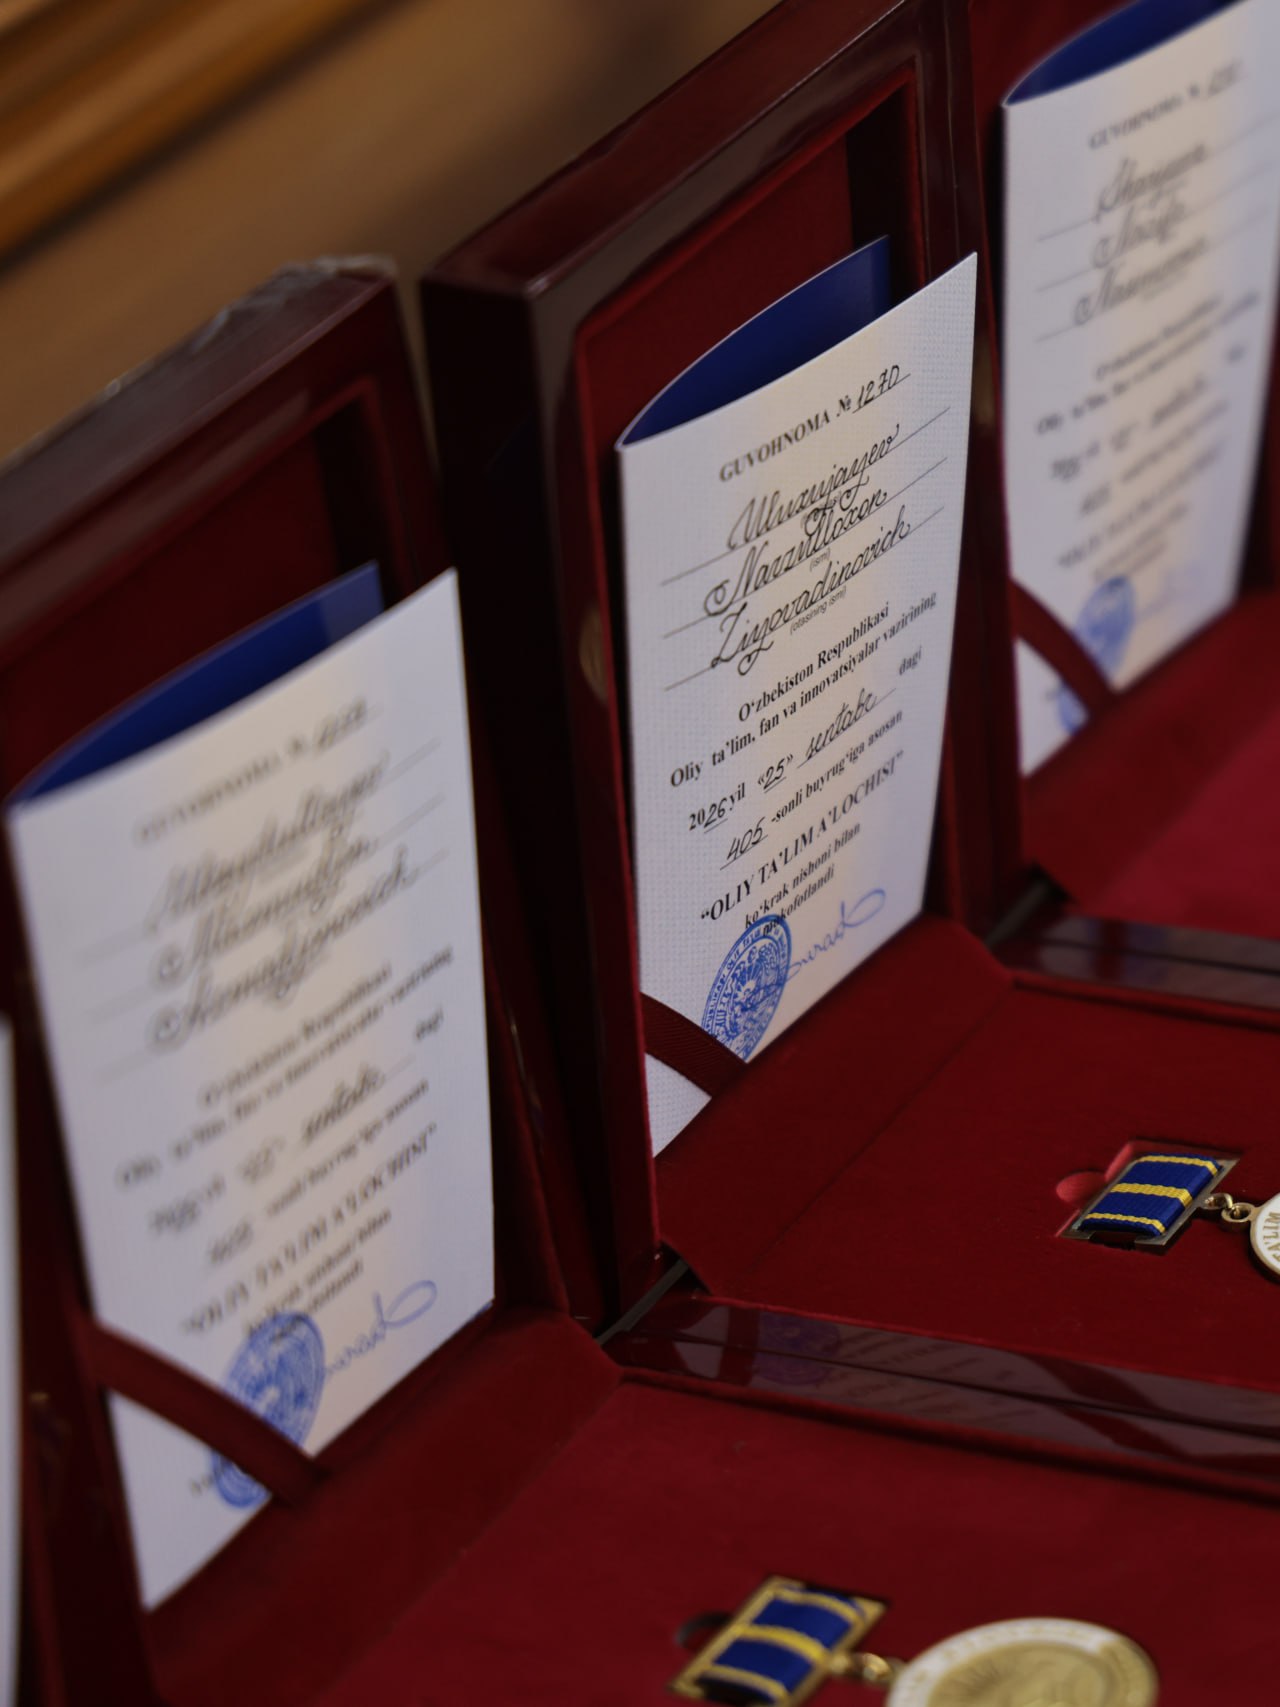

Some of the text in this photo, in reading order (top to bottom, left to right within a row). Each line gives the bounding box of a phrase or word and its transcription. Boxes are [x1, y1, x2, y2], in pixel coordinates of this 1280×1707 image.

[719, 410, 830, 482] GUVOHNOMA
[857, 364, 900, 408] 1270
[670, 761, 703, 787] Oliy
[759, 713, 779, 736] fan
[783, 701, 797, 718] va
[800, 636, 881, 708] innovatsiyalar
[883, 592, 937, 642] vazirining
[738, 601, 889, 722] O‘zbekiston Respublikasi
[689, 797, 727, 831] 2026
[729, 782, 745, 811] yil
[899, 644, 923, 676] dagi
[727, 816, 765, 860] 405
[867, 709, 903, 747] asosan
[701, 874, 754, 920] “OLIY
[792, 843, 832, 889] nishoni
[834, 823, 861, 853] bilan
